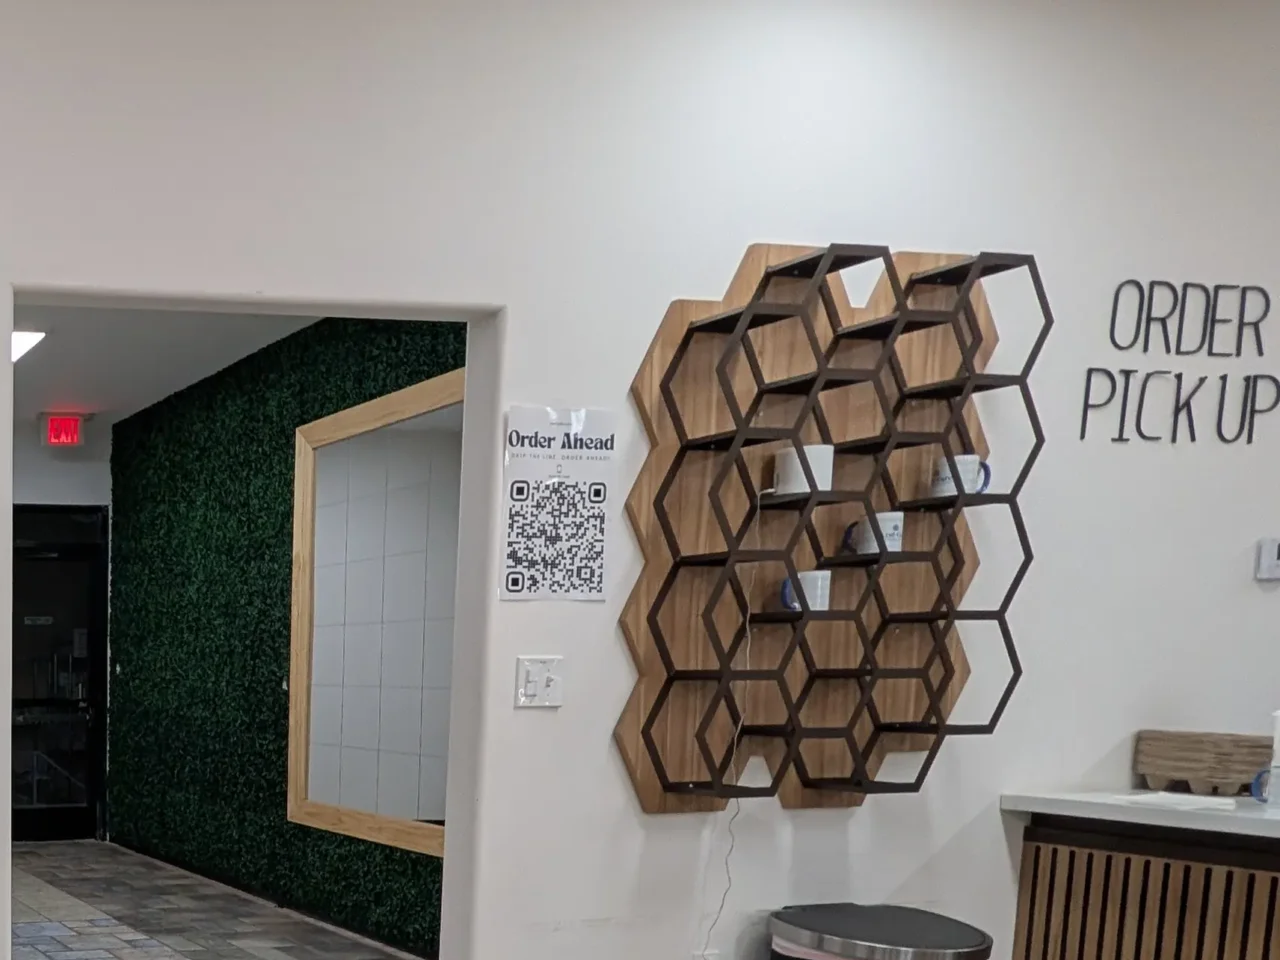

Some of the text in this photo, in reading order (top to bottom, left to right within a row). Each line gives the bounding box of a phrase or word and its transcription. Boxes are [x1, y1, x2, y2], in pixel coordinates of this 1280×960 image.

[1109, 279, 1271, 357] ORDER
[508, 429, 615, 451] Order Ahead
